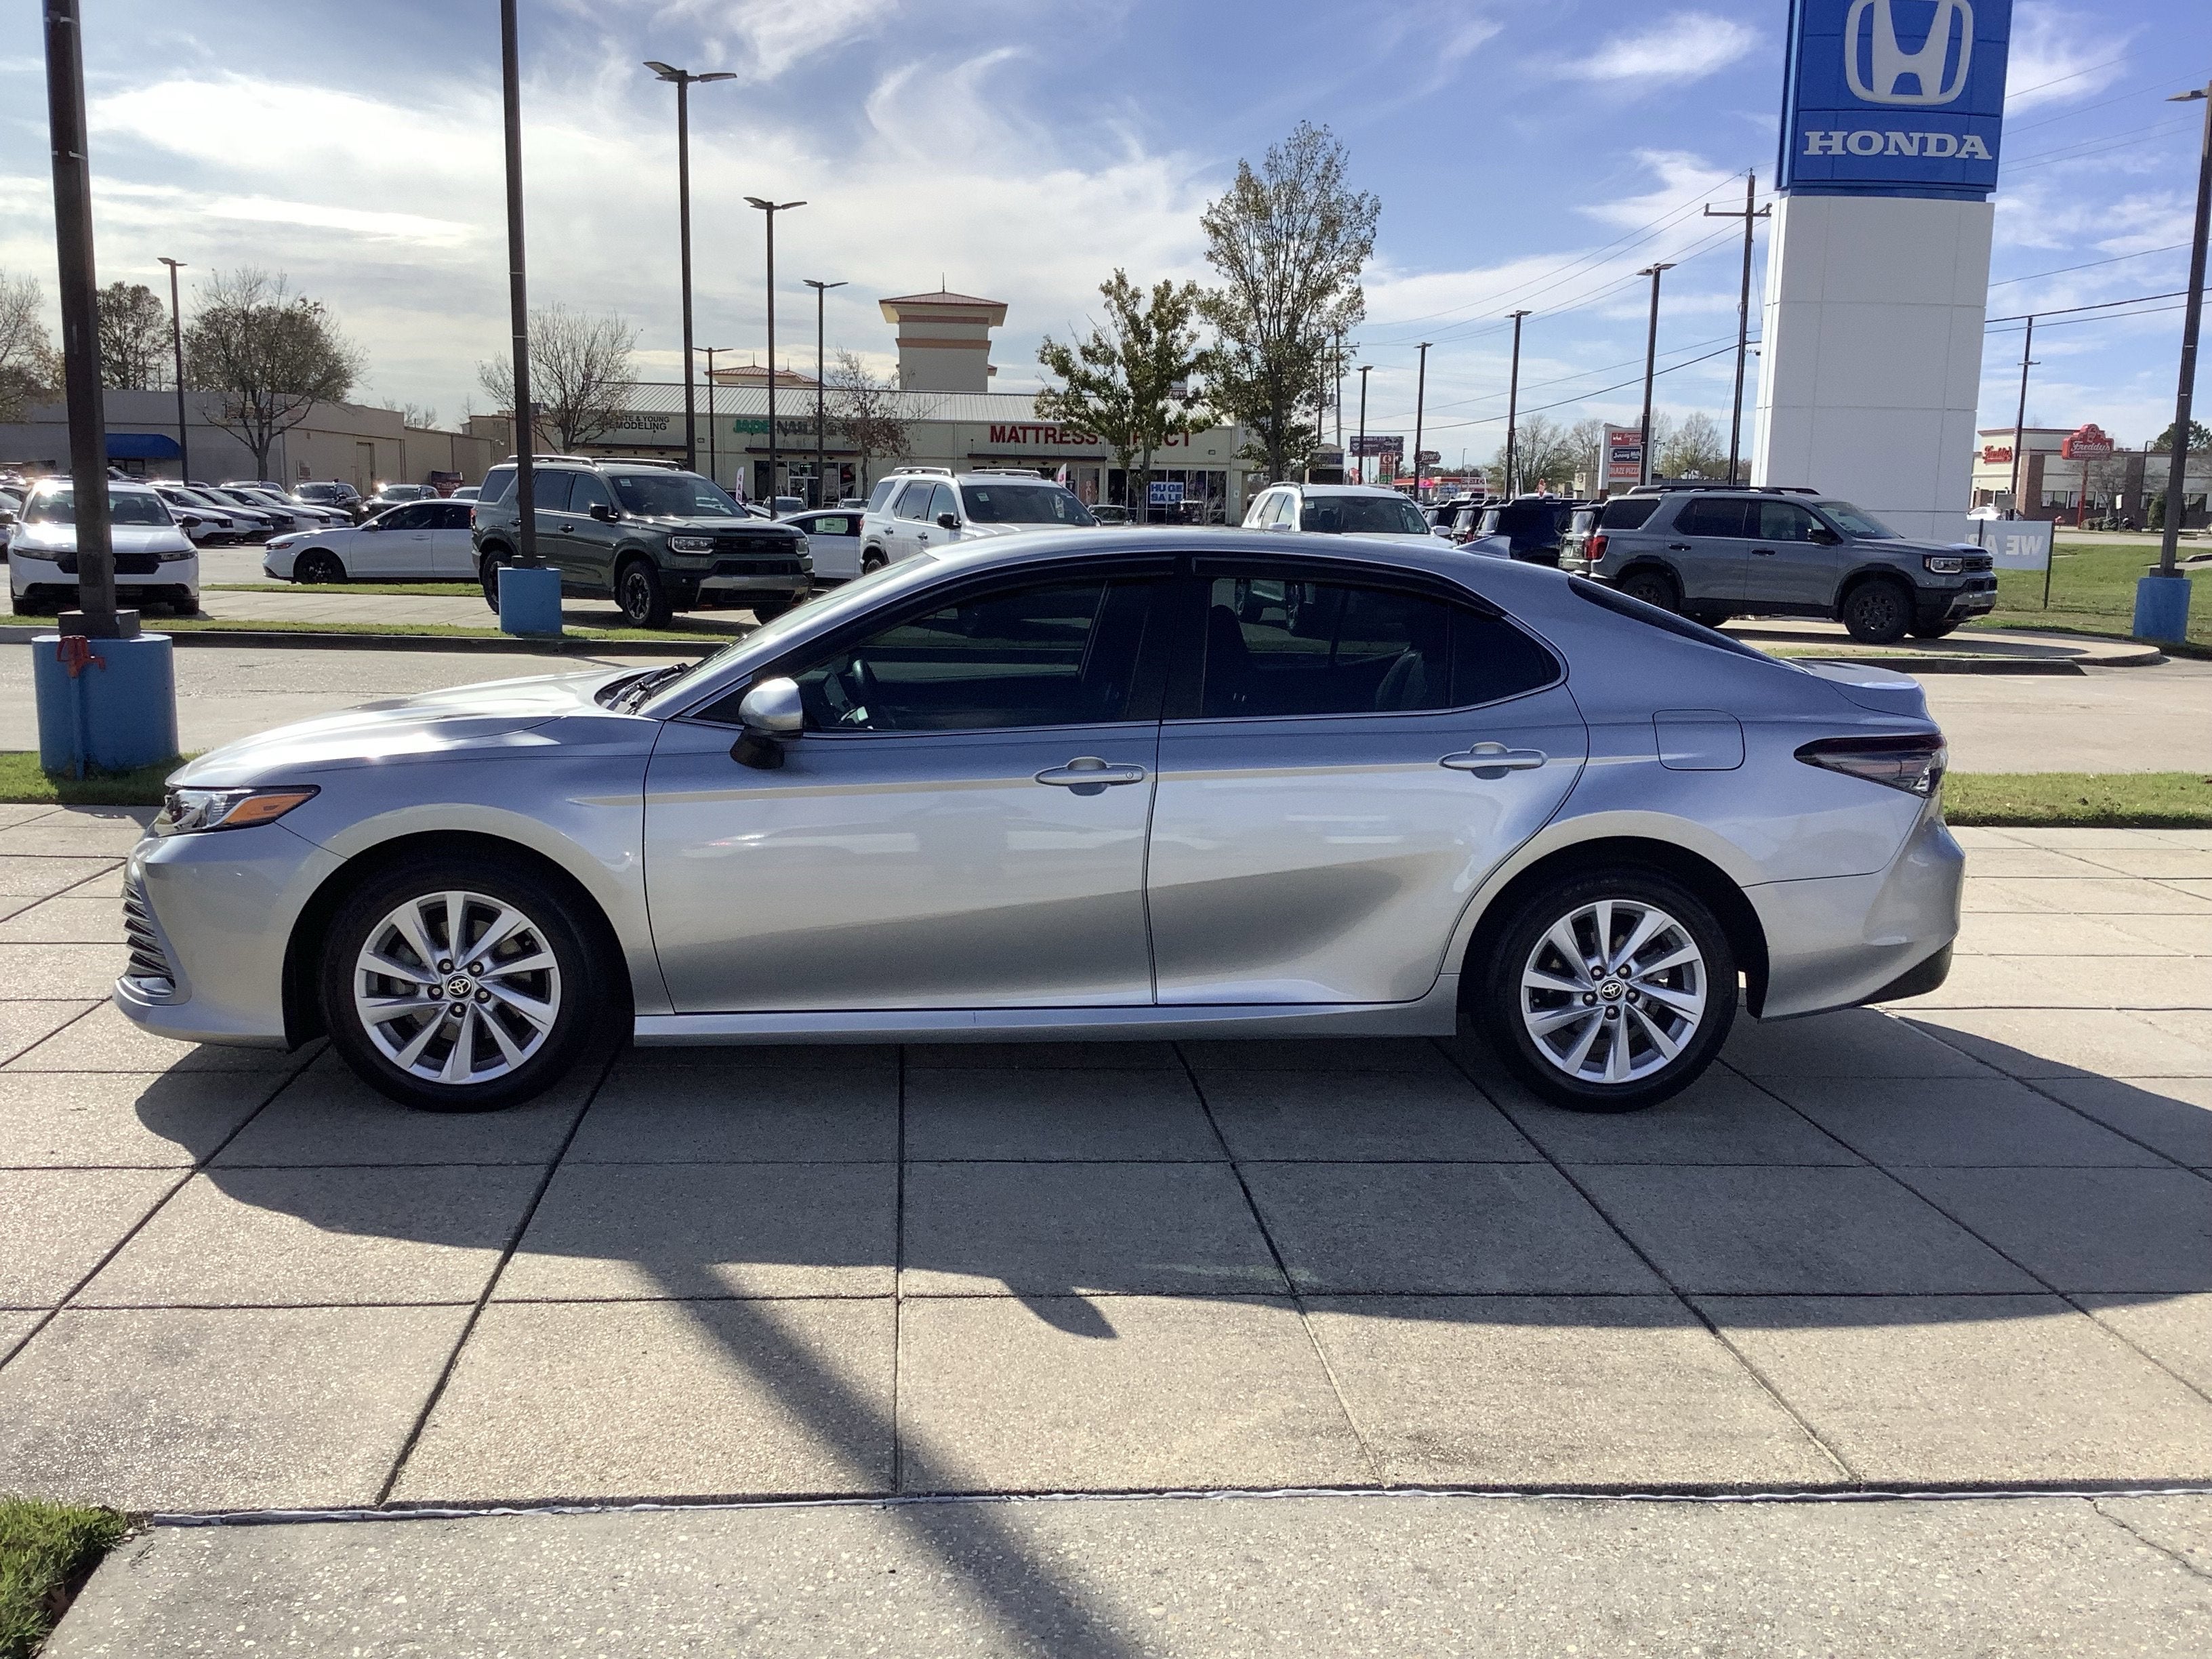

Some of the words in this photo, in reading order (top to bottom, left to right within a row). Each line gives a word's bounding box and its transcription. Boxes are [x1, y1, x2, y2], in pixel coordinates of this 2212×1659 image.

[1803, 130, 1992, 160] HONDA
[603, 421, 667, 430] EMODELING
[990, 426, 1099, 445] MATTRESS
[2071, 441, 2110, 452] Freddy's
[1151, 484, 1183, 492] HUGE
[1151, 493, 1182, 501] SALE
